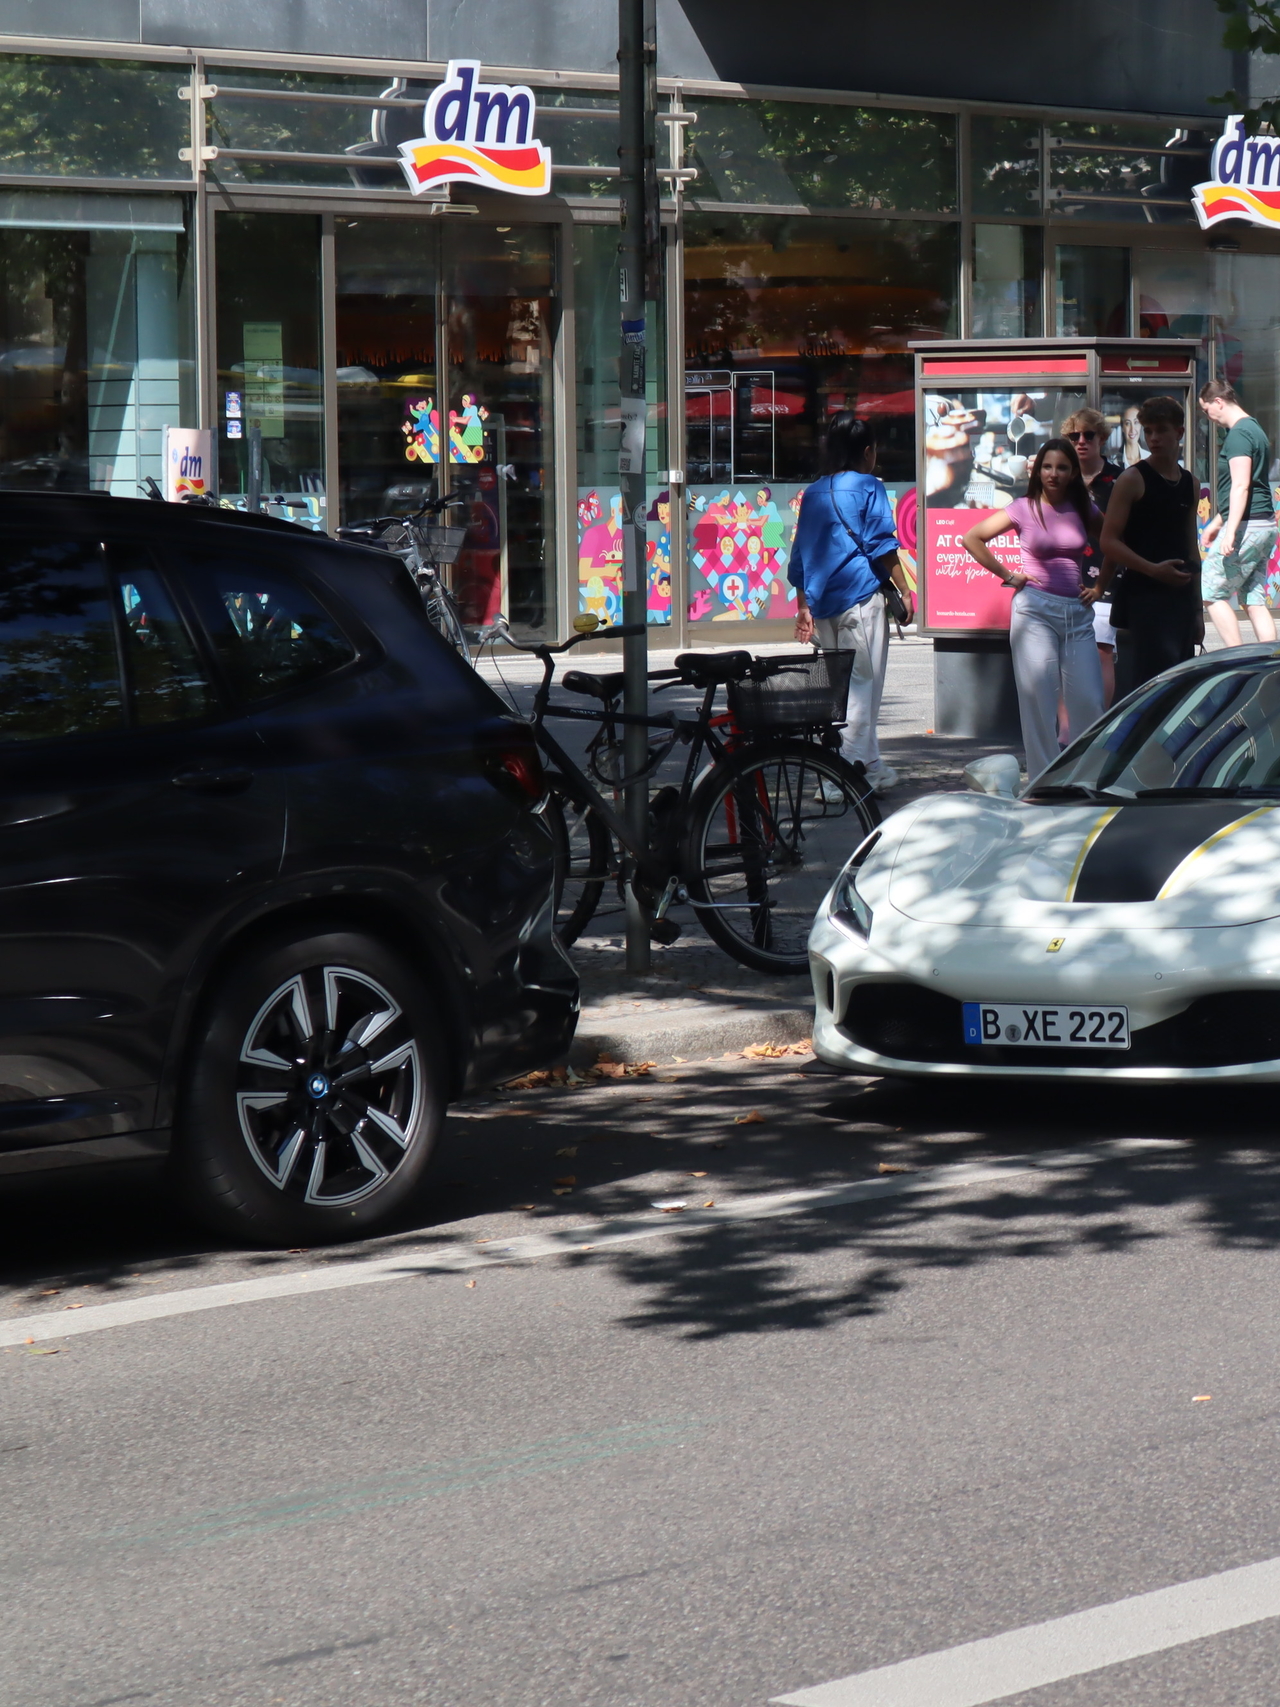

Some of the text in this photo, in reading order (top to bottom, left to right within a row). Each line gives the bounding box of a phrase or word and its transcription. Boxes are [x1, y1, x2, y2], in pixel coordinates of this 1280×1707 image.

[434, 67, 530, 145] dm
[180, 446, 202, 478] dm
[936, 534, 952, 547] AT
[969, 1027, 977, 1037] D
[982, 1009, 1126, 1043] B XE 222
